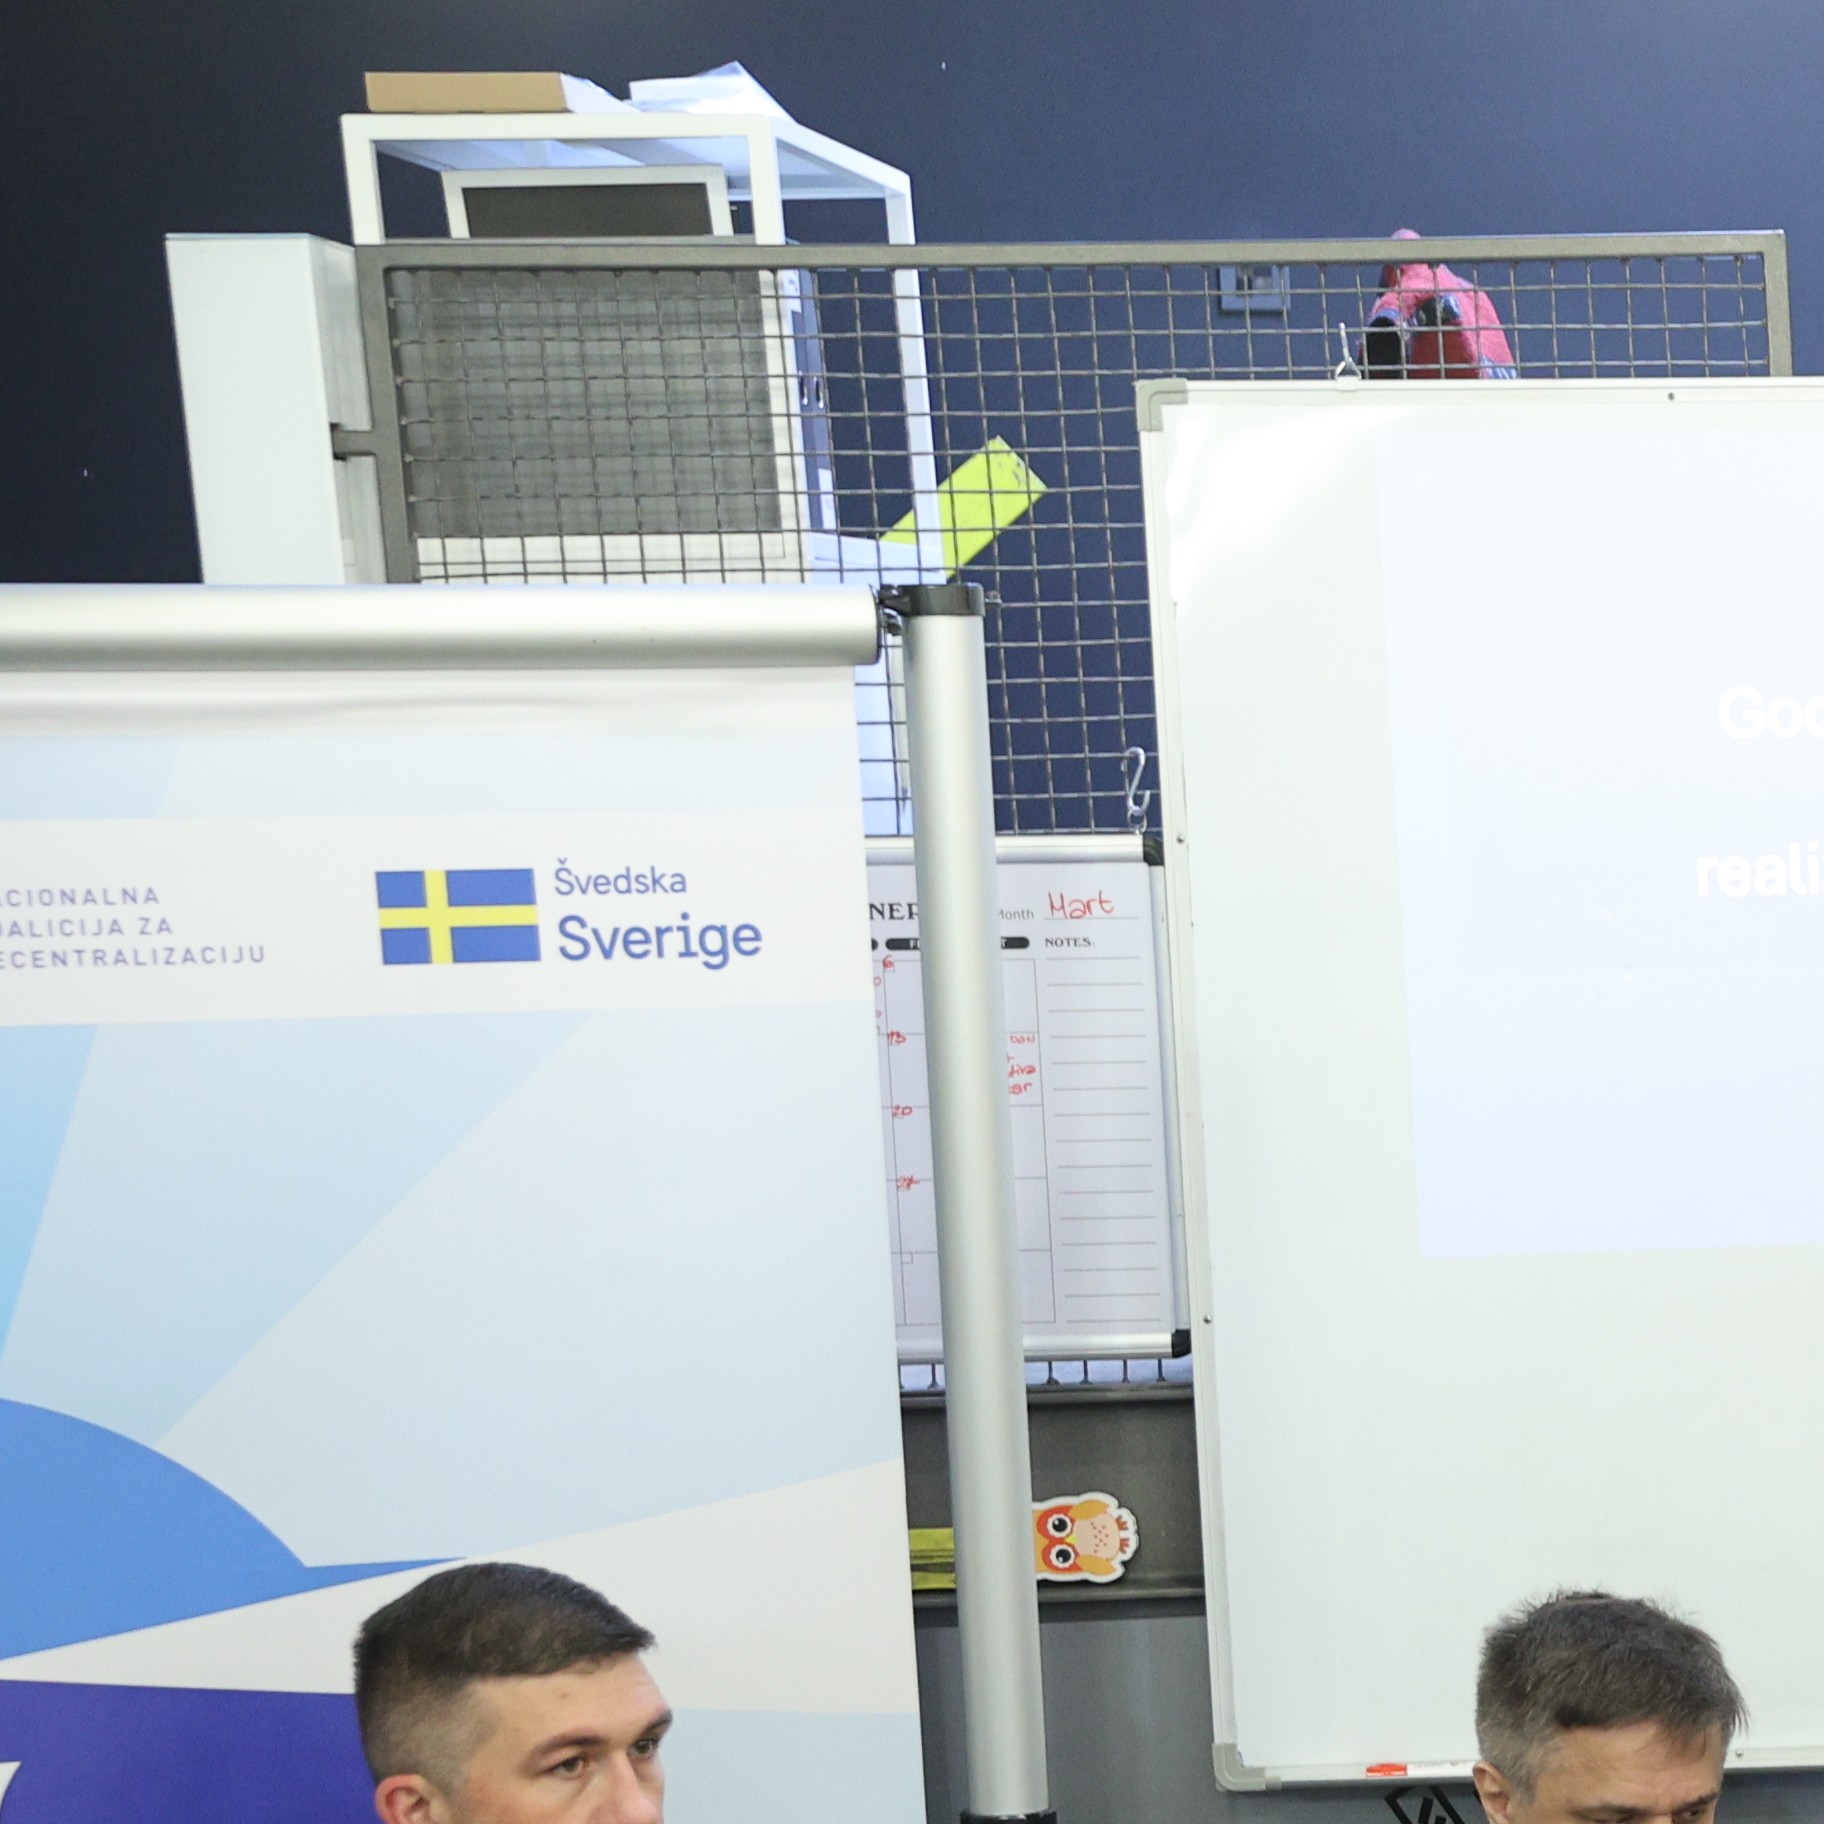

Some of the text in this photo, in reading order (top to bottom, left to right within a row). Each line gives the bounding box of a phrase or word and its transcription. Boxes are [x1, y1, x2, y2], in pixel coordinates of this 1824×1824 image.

[554, 857, 688, 897] Švedska
[1047, 889, 1115, 920] Mart
[0, 918, 173, 938] ALICIJA ZA
[557, 911, 763, 971] Sverige
